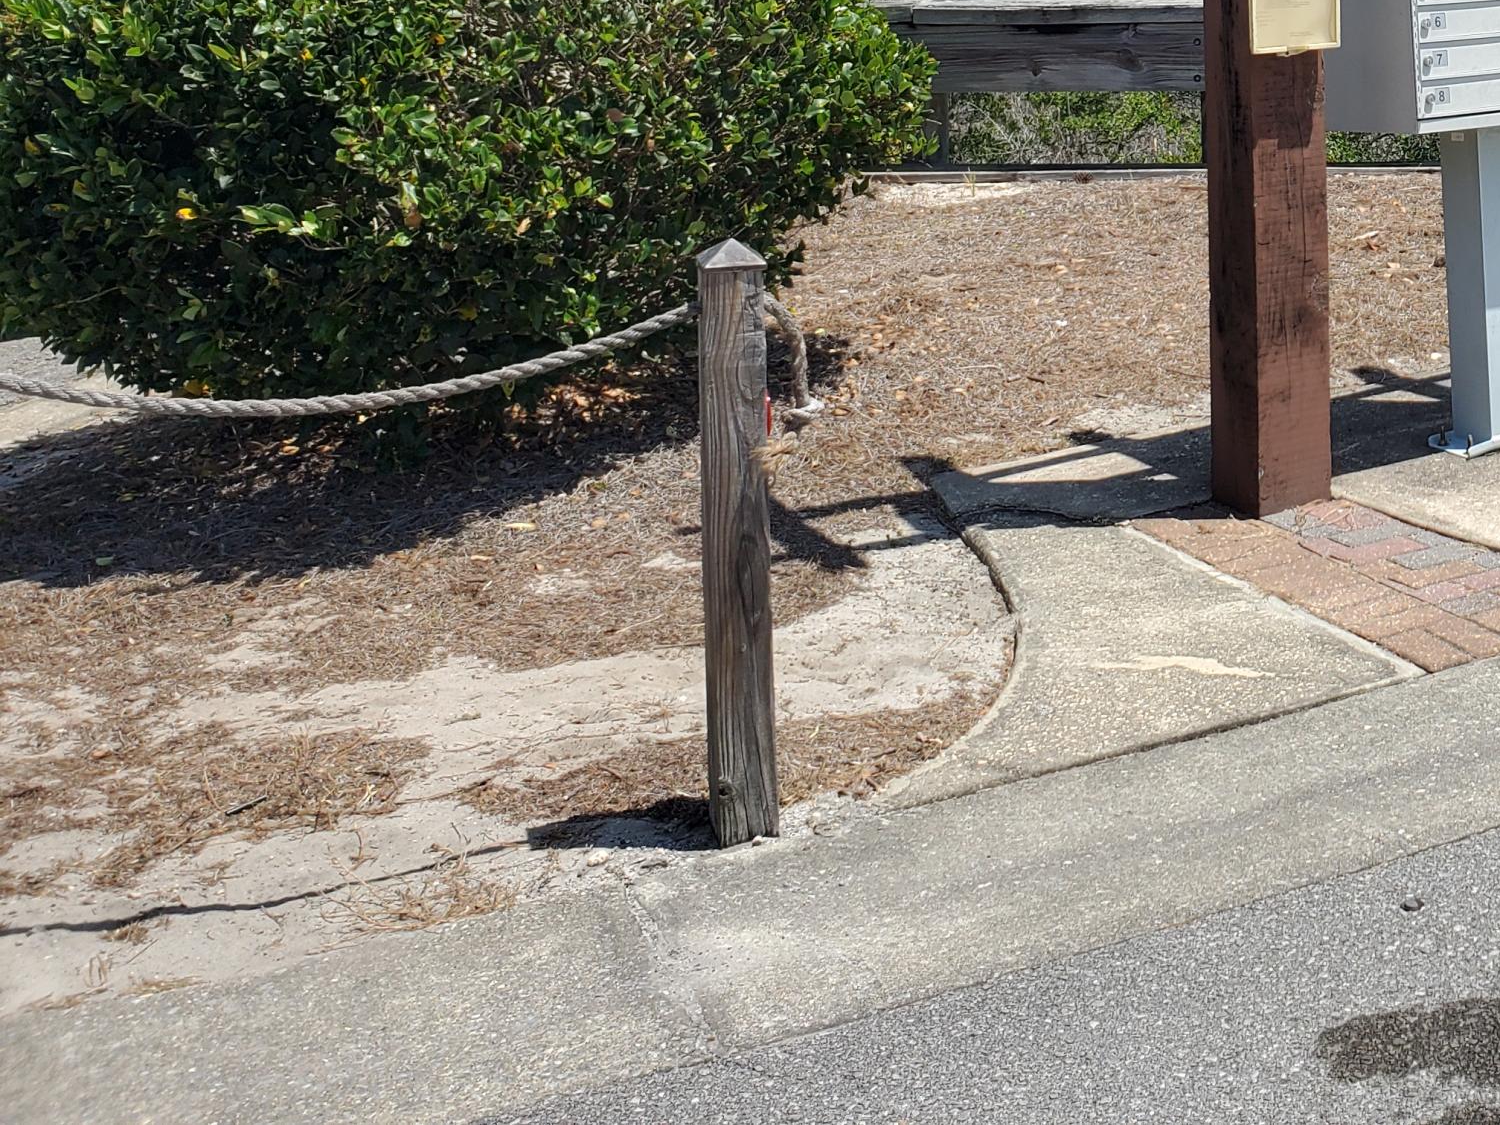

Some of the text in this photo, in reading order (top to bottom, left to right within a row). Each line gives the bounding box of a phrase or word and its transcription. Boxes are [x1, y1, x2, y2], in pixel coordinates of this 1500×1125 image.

[1434, 16, 1441, 28] 6
[1436, 53, 1443, 65] 7
[1438, 90, 1445, 102] 8
